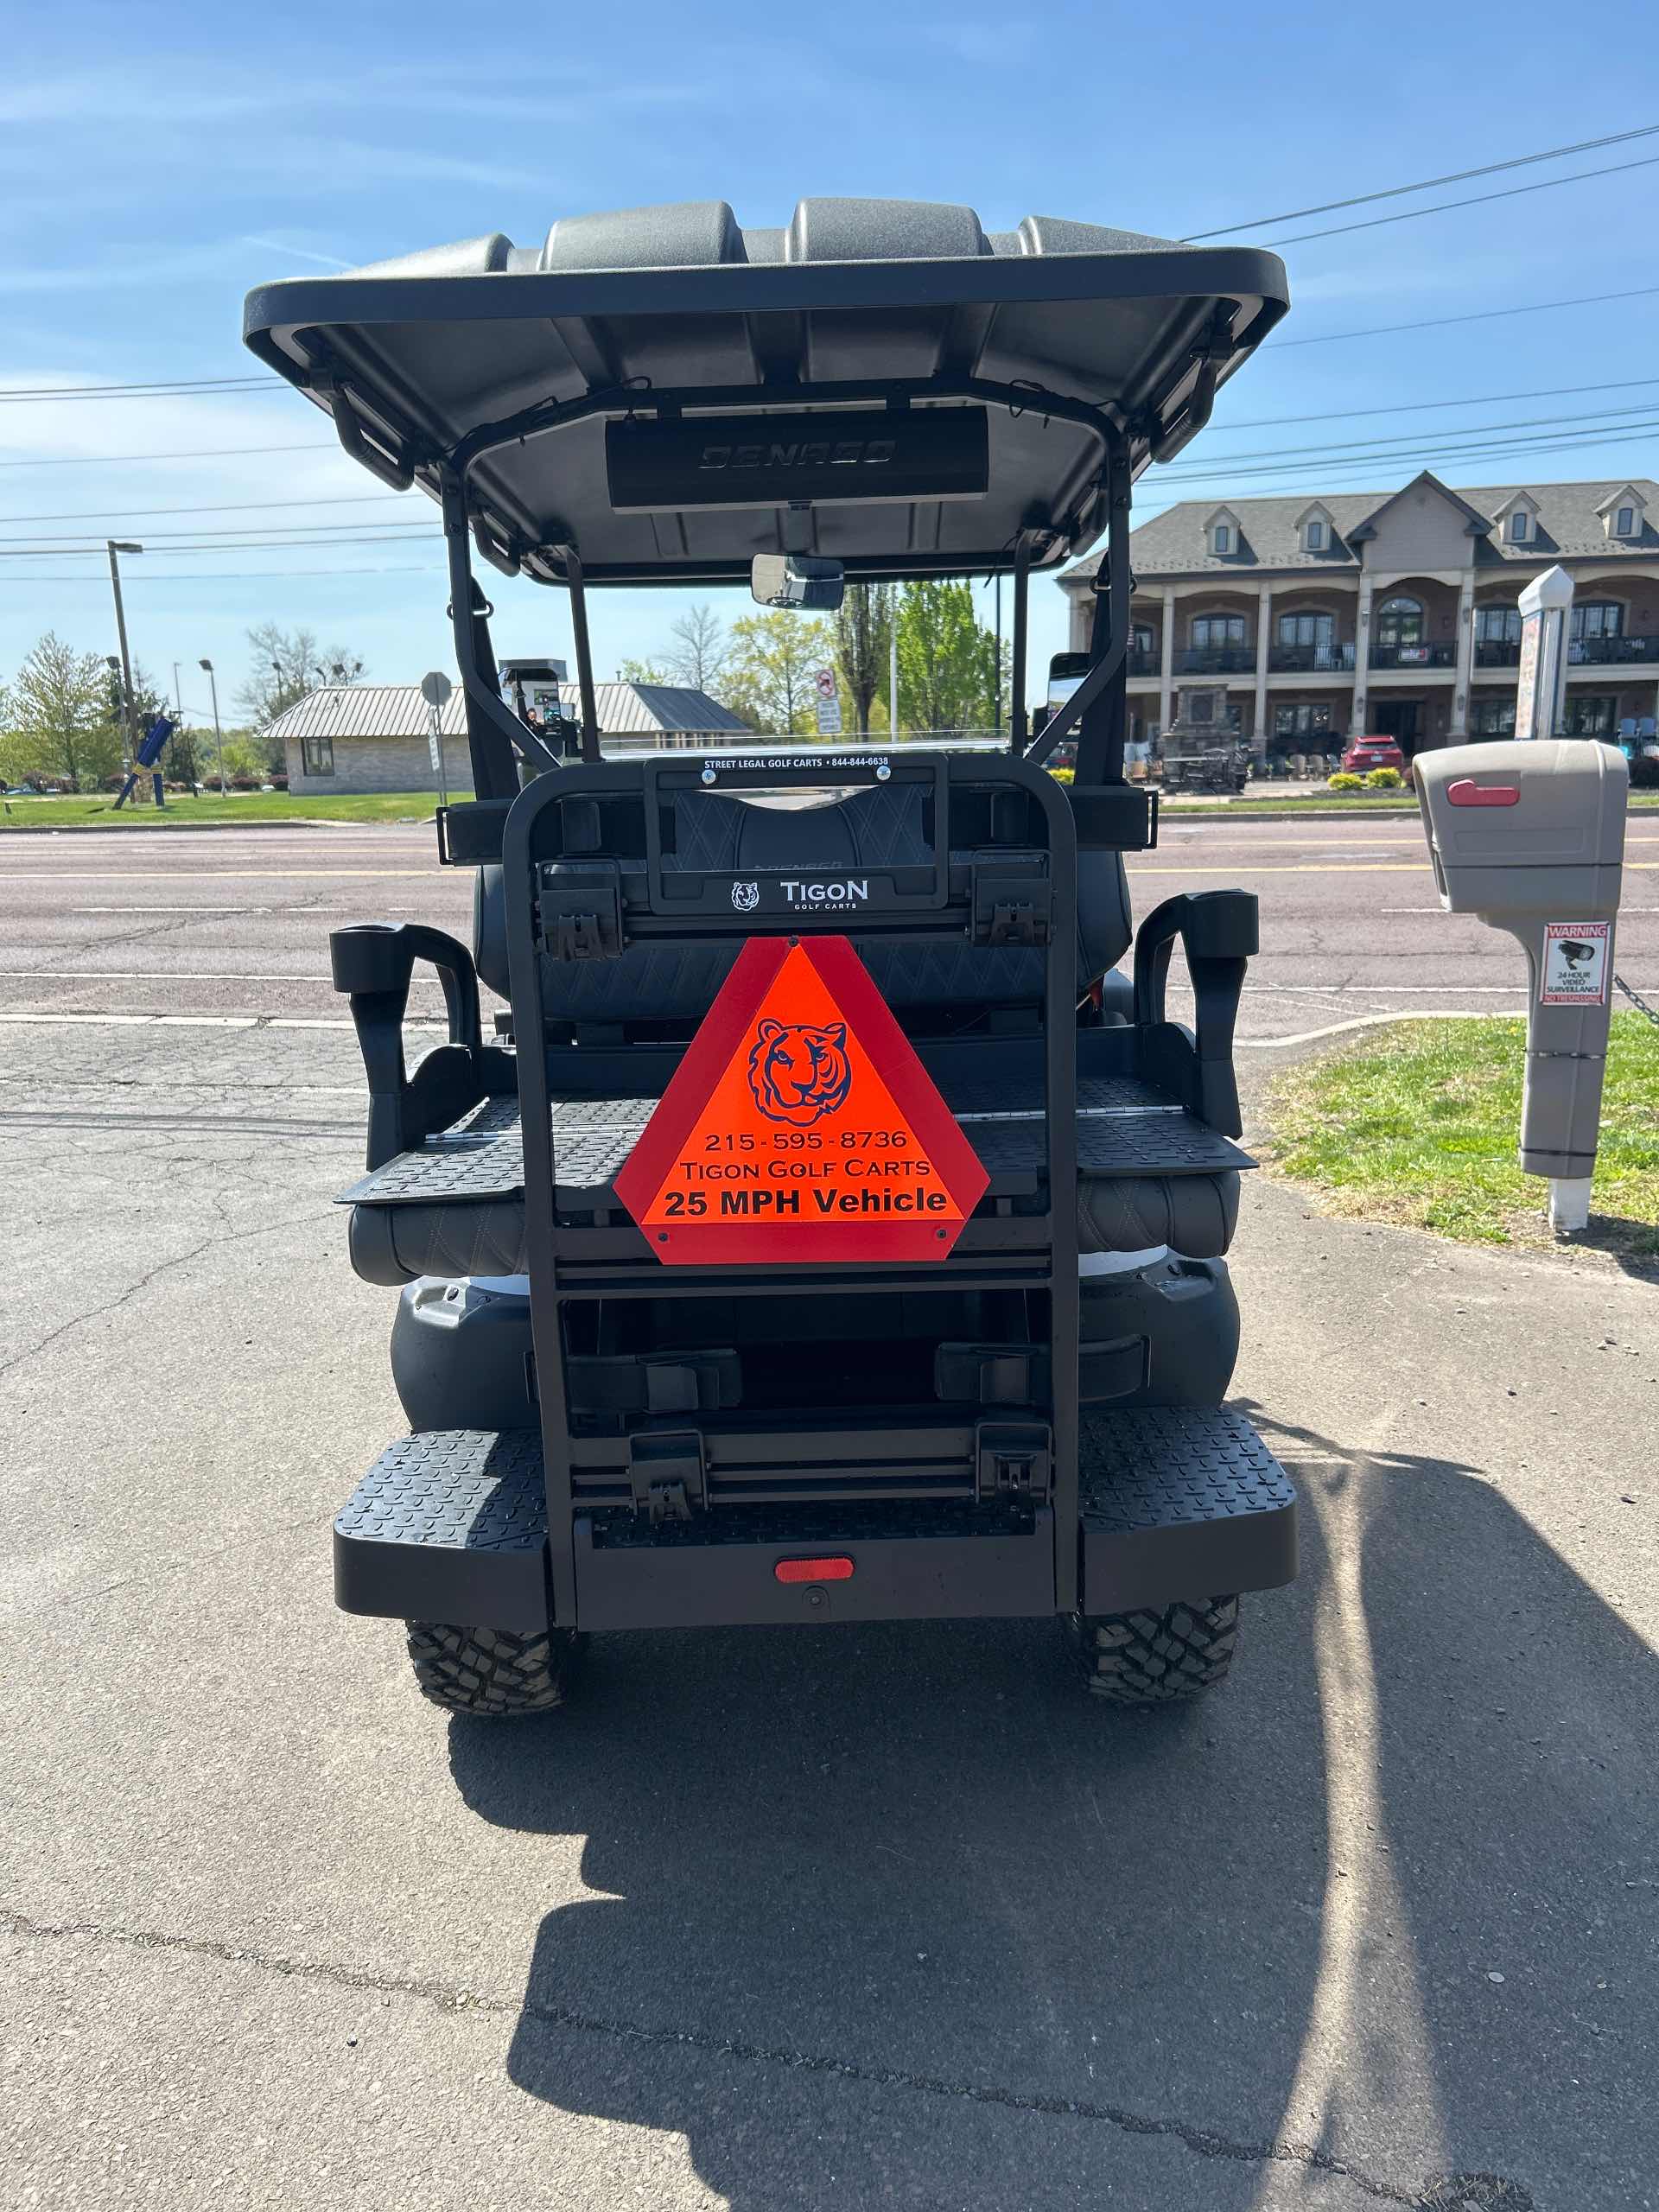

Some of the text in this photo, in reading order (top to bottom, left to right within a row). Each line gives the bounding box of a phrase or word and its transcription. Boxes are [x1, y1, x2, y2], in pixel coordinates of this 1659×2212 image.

[704, 757, 888, 769] STREET LEGAL GOLF CARTS 844-844-6638
[1548, 925, 1606, 938] WARNING
[664, 1187, 947, 1217] 25 MPH Vehicle
